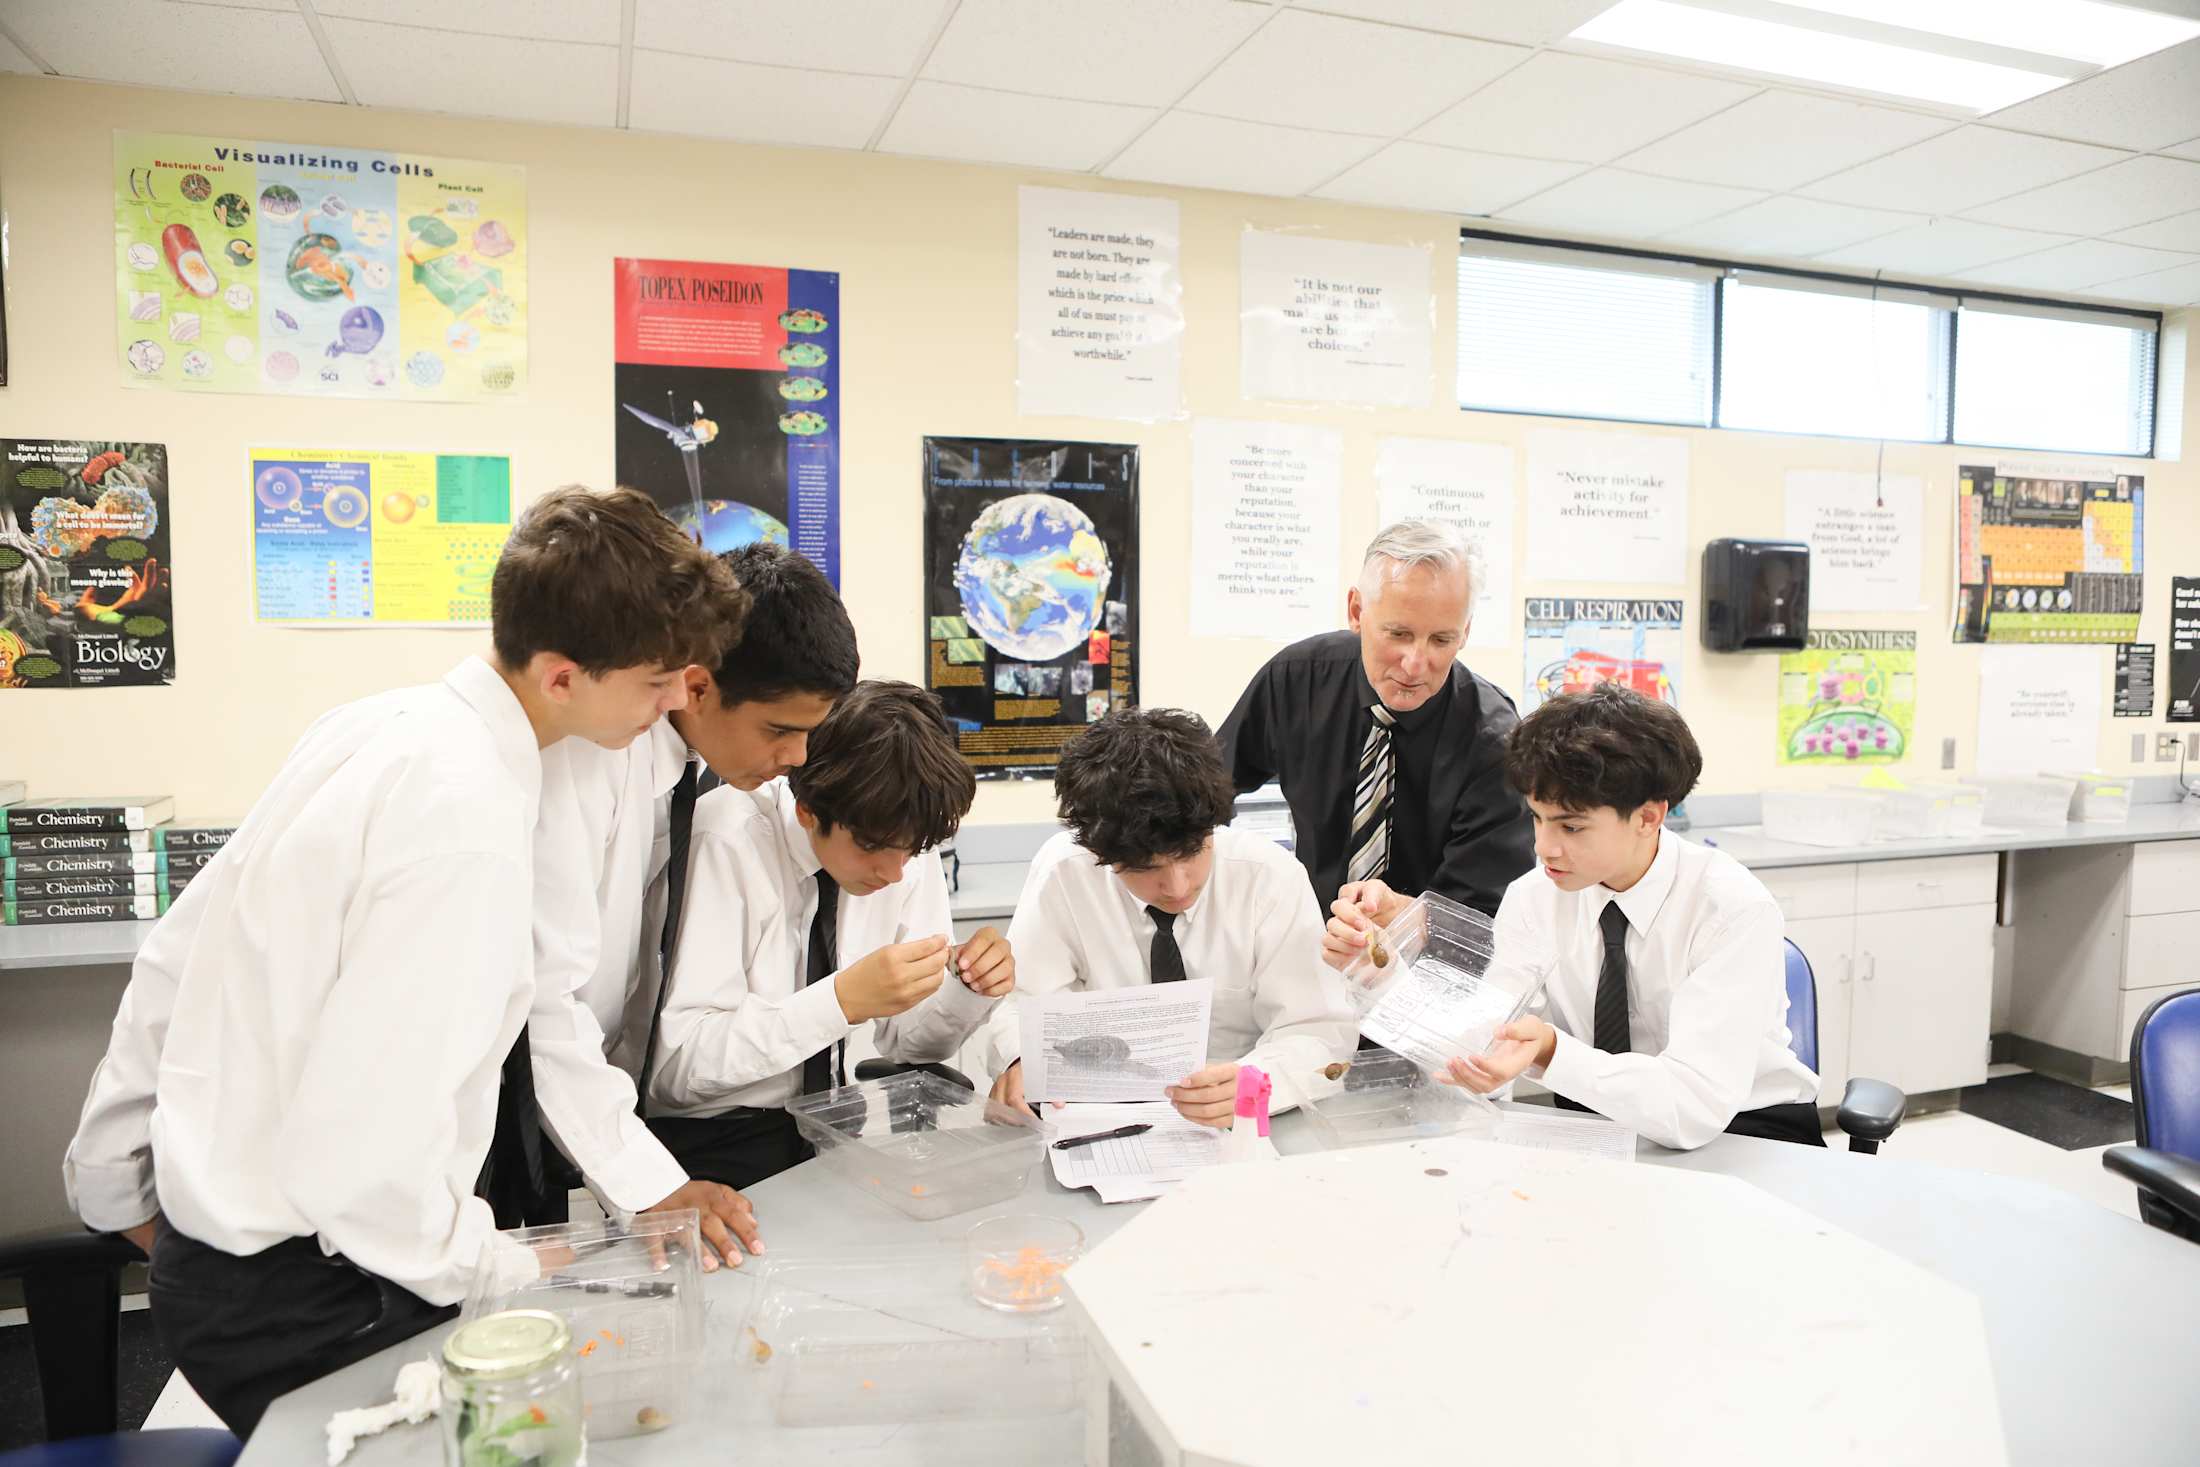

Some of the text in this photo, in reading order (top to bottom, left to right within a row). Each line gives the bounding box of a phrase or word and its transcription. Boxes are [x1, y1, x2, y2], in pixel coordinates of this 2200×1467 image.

[155, 160, 224, 173] Bacterial Cell
[214, 147, 434, 178] Visualizing Cells
[438, 183, 484, 193] Plant Cell
[1091, 232, 1105, 242] are
[1107, 231, 1134, 245] made,
[1135, 232, 1154, 249] they
[1053, 249, 1068, 258] are
[1070, 250, 1084, 259] not
[1087, 249, 1111, 262] born.
[1112, 252, 1134, 266] They
[1056, 267, 1081, 280] made
[1083, 269, 1093, 283] by
[1095, 270, 1117, 283] hard
[1048, 286, 1075, 299] which
[1077, 288, 1086, 299] is
[1087, 288, 1101, 301] the
[1317, 279, 1329, 290] is
[1332, 283, 1353, 293] not
[1357, 286, 1383, 296] our
[1354, 298, 1381, 310] that
[1058, 306, 1069, 318] all
[1071, 308, 1082, 319] of
[1082, 312, 1094, 320] us
[1095, 312, 1117, 321] must
[1324, 312, 1340, 322] us
[1051, 327, 1085, 339] achieve
[1087, 331, 1102, 342] any
[17, 443, 38, 452] How
[53, 444, 88, 454] bacteria
[8, 452, 88, 463] helpful to humans?
[1231, 471, 1256, 481] your
[1611, 473, 1665, 488] mistake
[1244, 482, 1293, 496] than your
[1573, 489, 1650, 504] activity for
[1427, 499, 1462, 512] effort
[56, 511, 79, 520] What
[1234, 508, 1275, 519] because
[1224, 520, 1275, 531] character
[1287, 524, 1312, 533] what
[1478, 520, 1493, 528] or
[1231, 535, 1250, 545] you
[1253, 535, 1281, 545] really
[1240, 547, 1294, 559] while your
[89, 568, 133, 580] Why is this
[1217, 572, 1315, 584] merely what others
[98, 577, 133, 588] glowing?
[1228, 583, 1257, 594] think
[1526, 600, 1682, 622] CELL RESPIRATION
[1808, 631, 1916, 650] OTOSYNTHESIS
[76, 639, 167, 670] Biology
[37, 813, 104, 827] Chemistry
[41, 836, 108, 850] Chemistry
[46, 859, 113, 873] Chemistry
[46, 882, 114, 896] Chemistry
[47, 904, 114, 918] Chemistry
